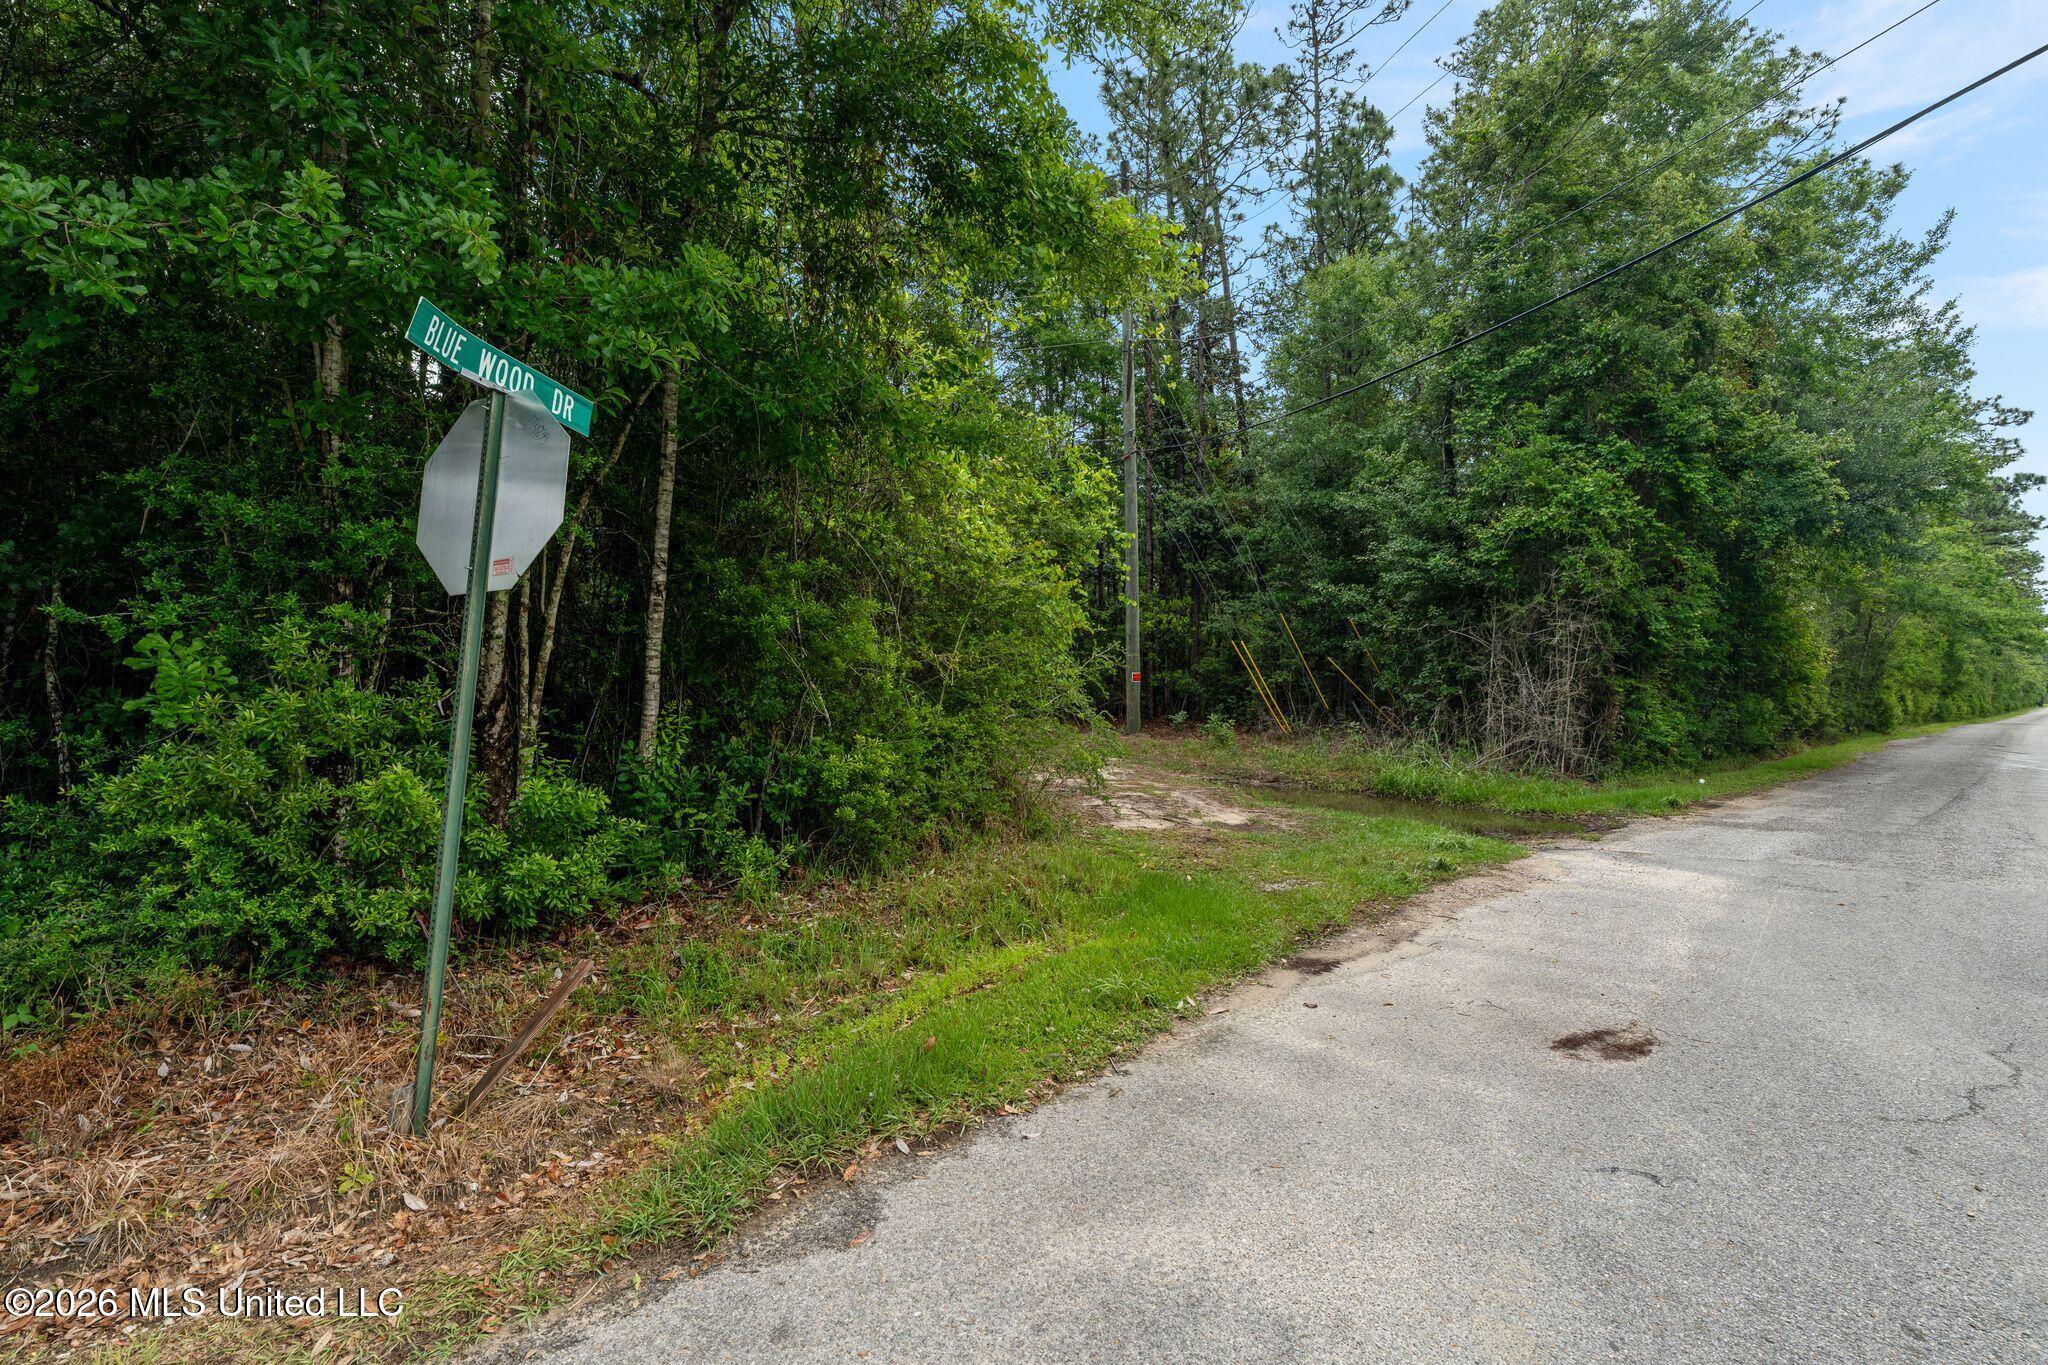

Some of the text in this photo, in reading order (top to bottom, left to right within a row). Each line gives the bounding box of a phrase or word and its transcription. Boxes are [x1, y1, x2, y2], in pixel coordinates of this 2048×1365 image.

[424, 314, 574, 422] BLUE WOOD DR
